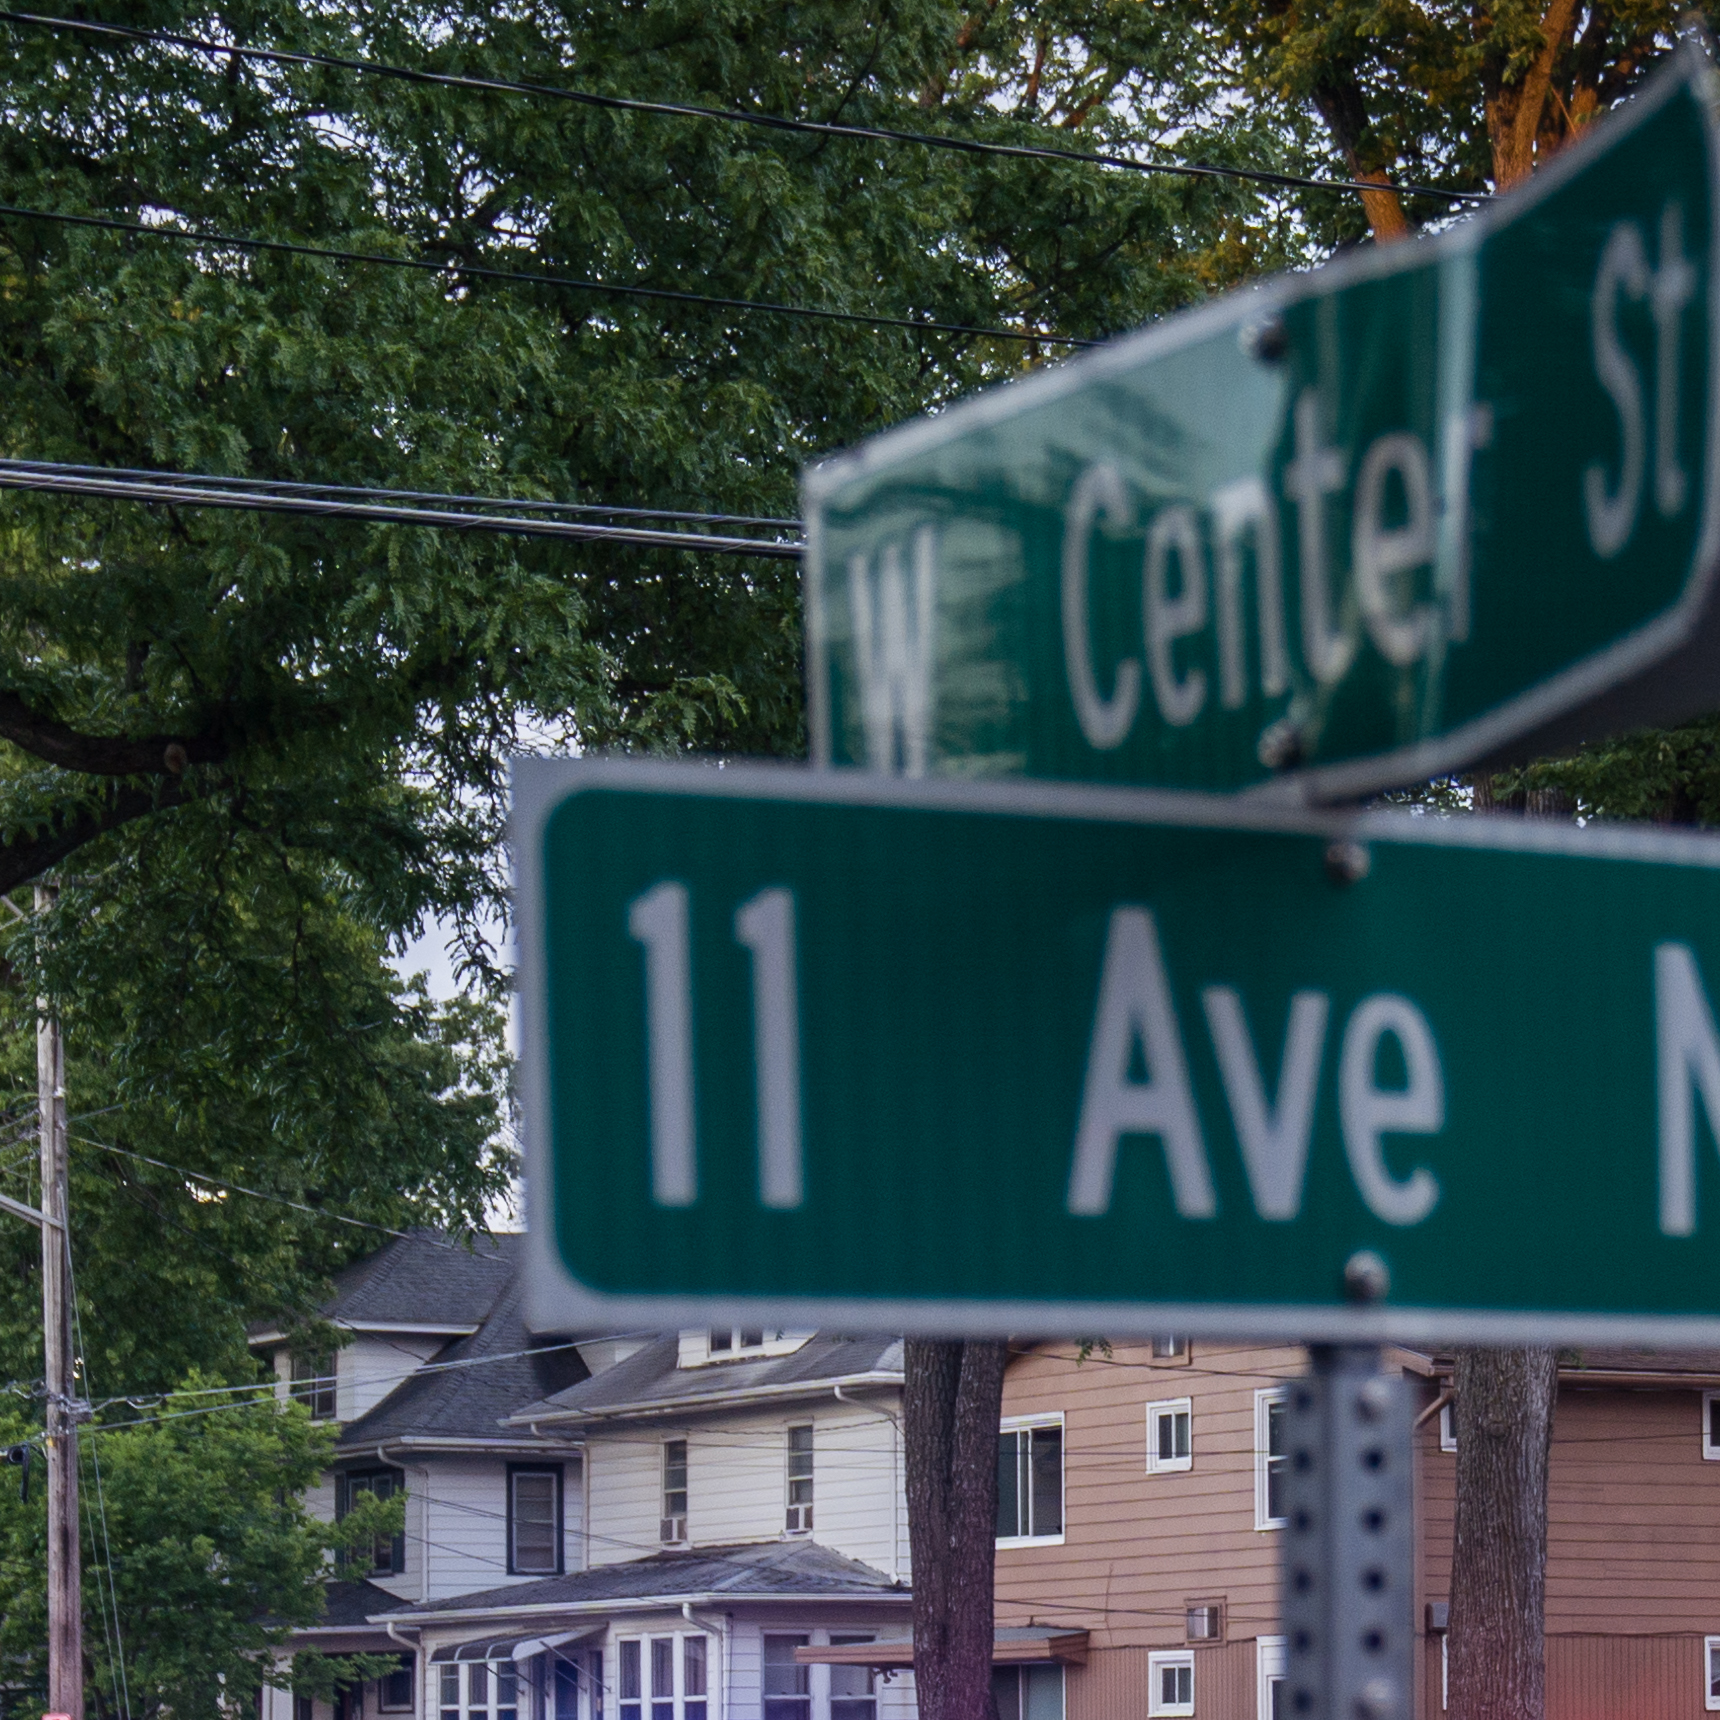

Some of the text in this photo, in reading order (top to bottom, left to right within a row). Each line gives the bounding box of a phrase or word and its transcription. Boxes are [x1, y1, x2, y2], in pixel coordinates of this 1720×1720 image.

[848, 222, 1696, 780] W Center St
[627, 880, 806, 1208] 11
[1066, 906, 1447, 1226] Ave
